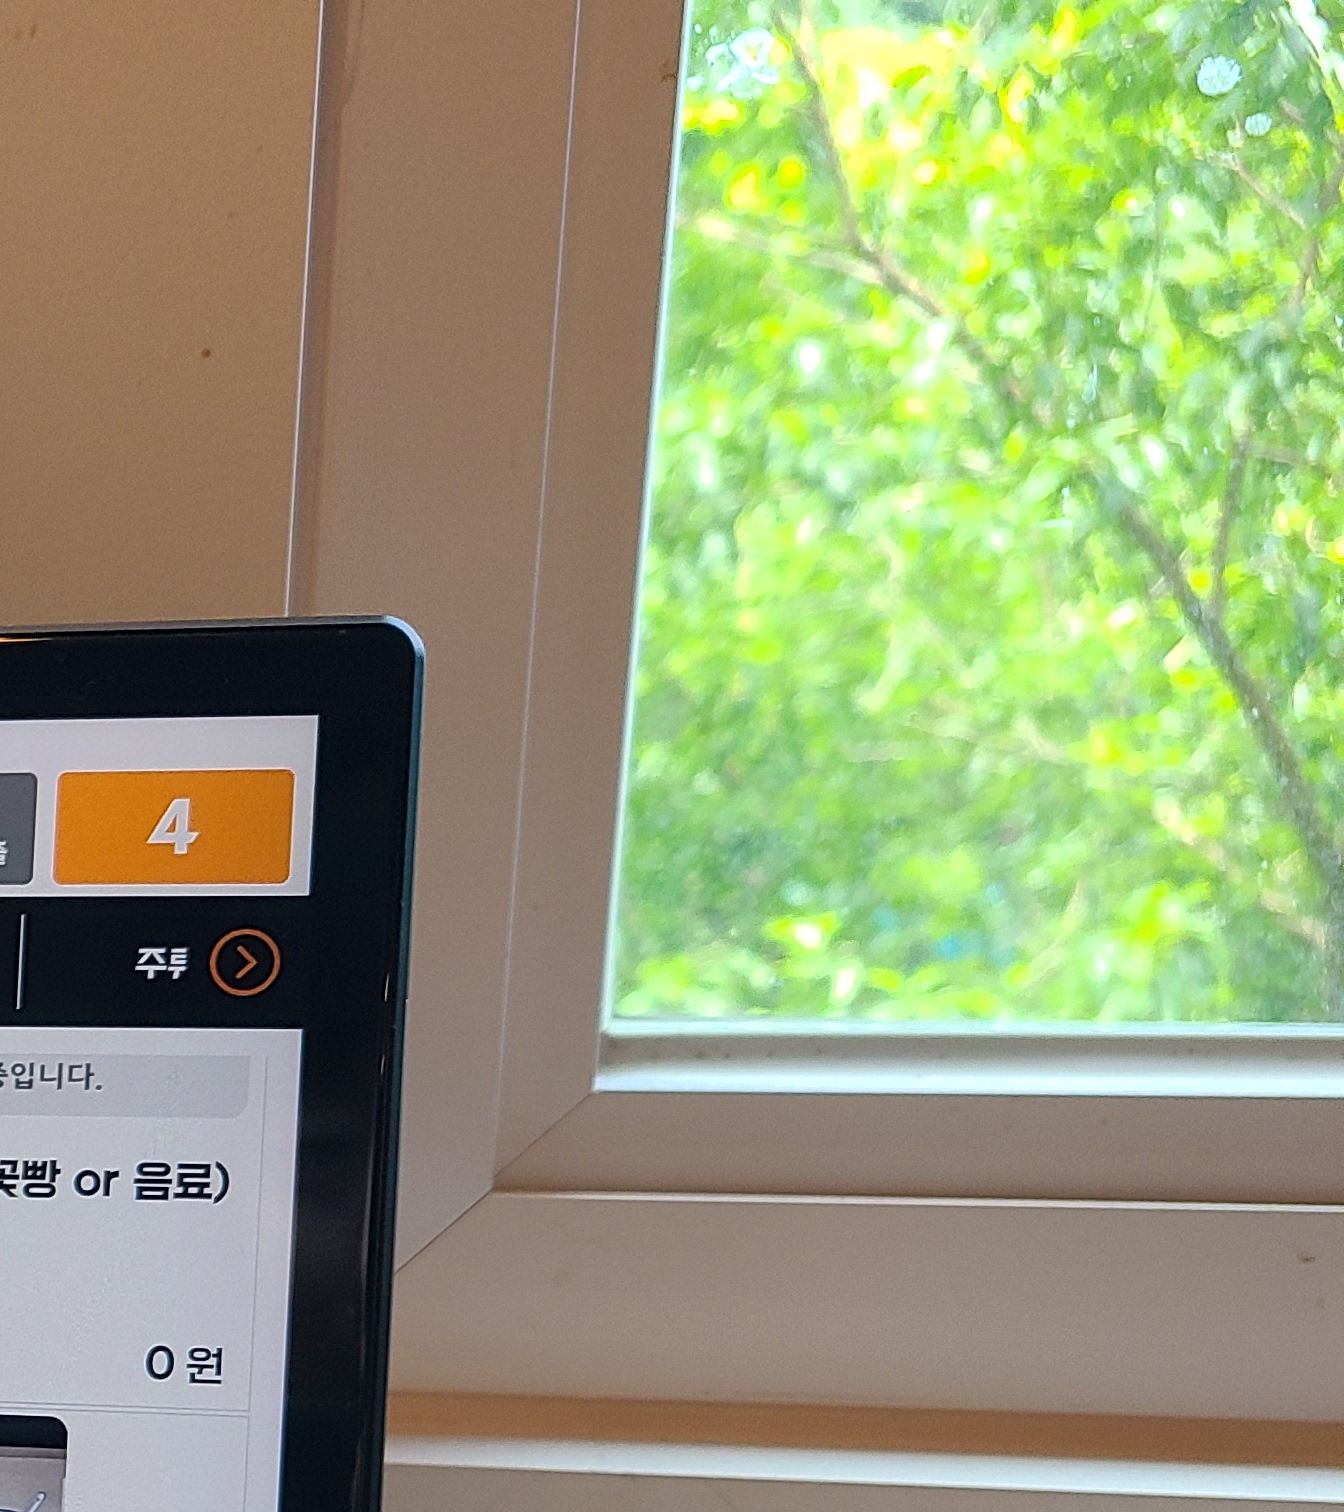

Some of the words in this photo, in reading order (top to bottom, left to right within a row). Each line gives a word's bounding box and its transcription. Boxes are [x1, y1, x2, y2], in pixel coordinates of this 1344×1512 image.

[146, 798, 200, 855] 4
[73, 1169, 120, 1197] or
[133, 1161, 230, 1204] 음료)
[186, 1347, 223, 1385] 원
